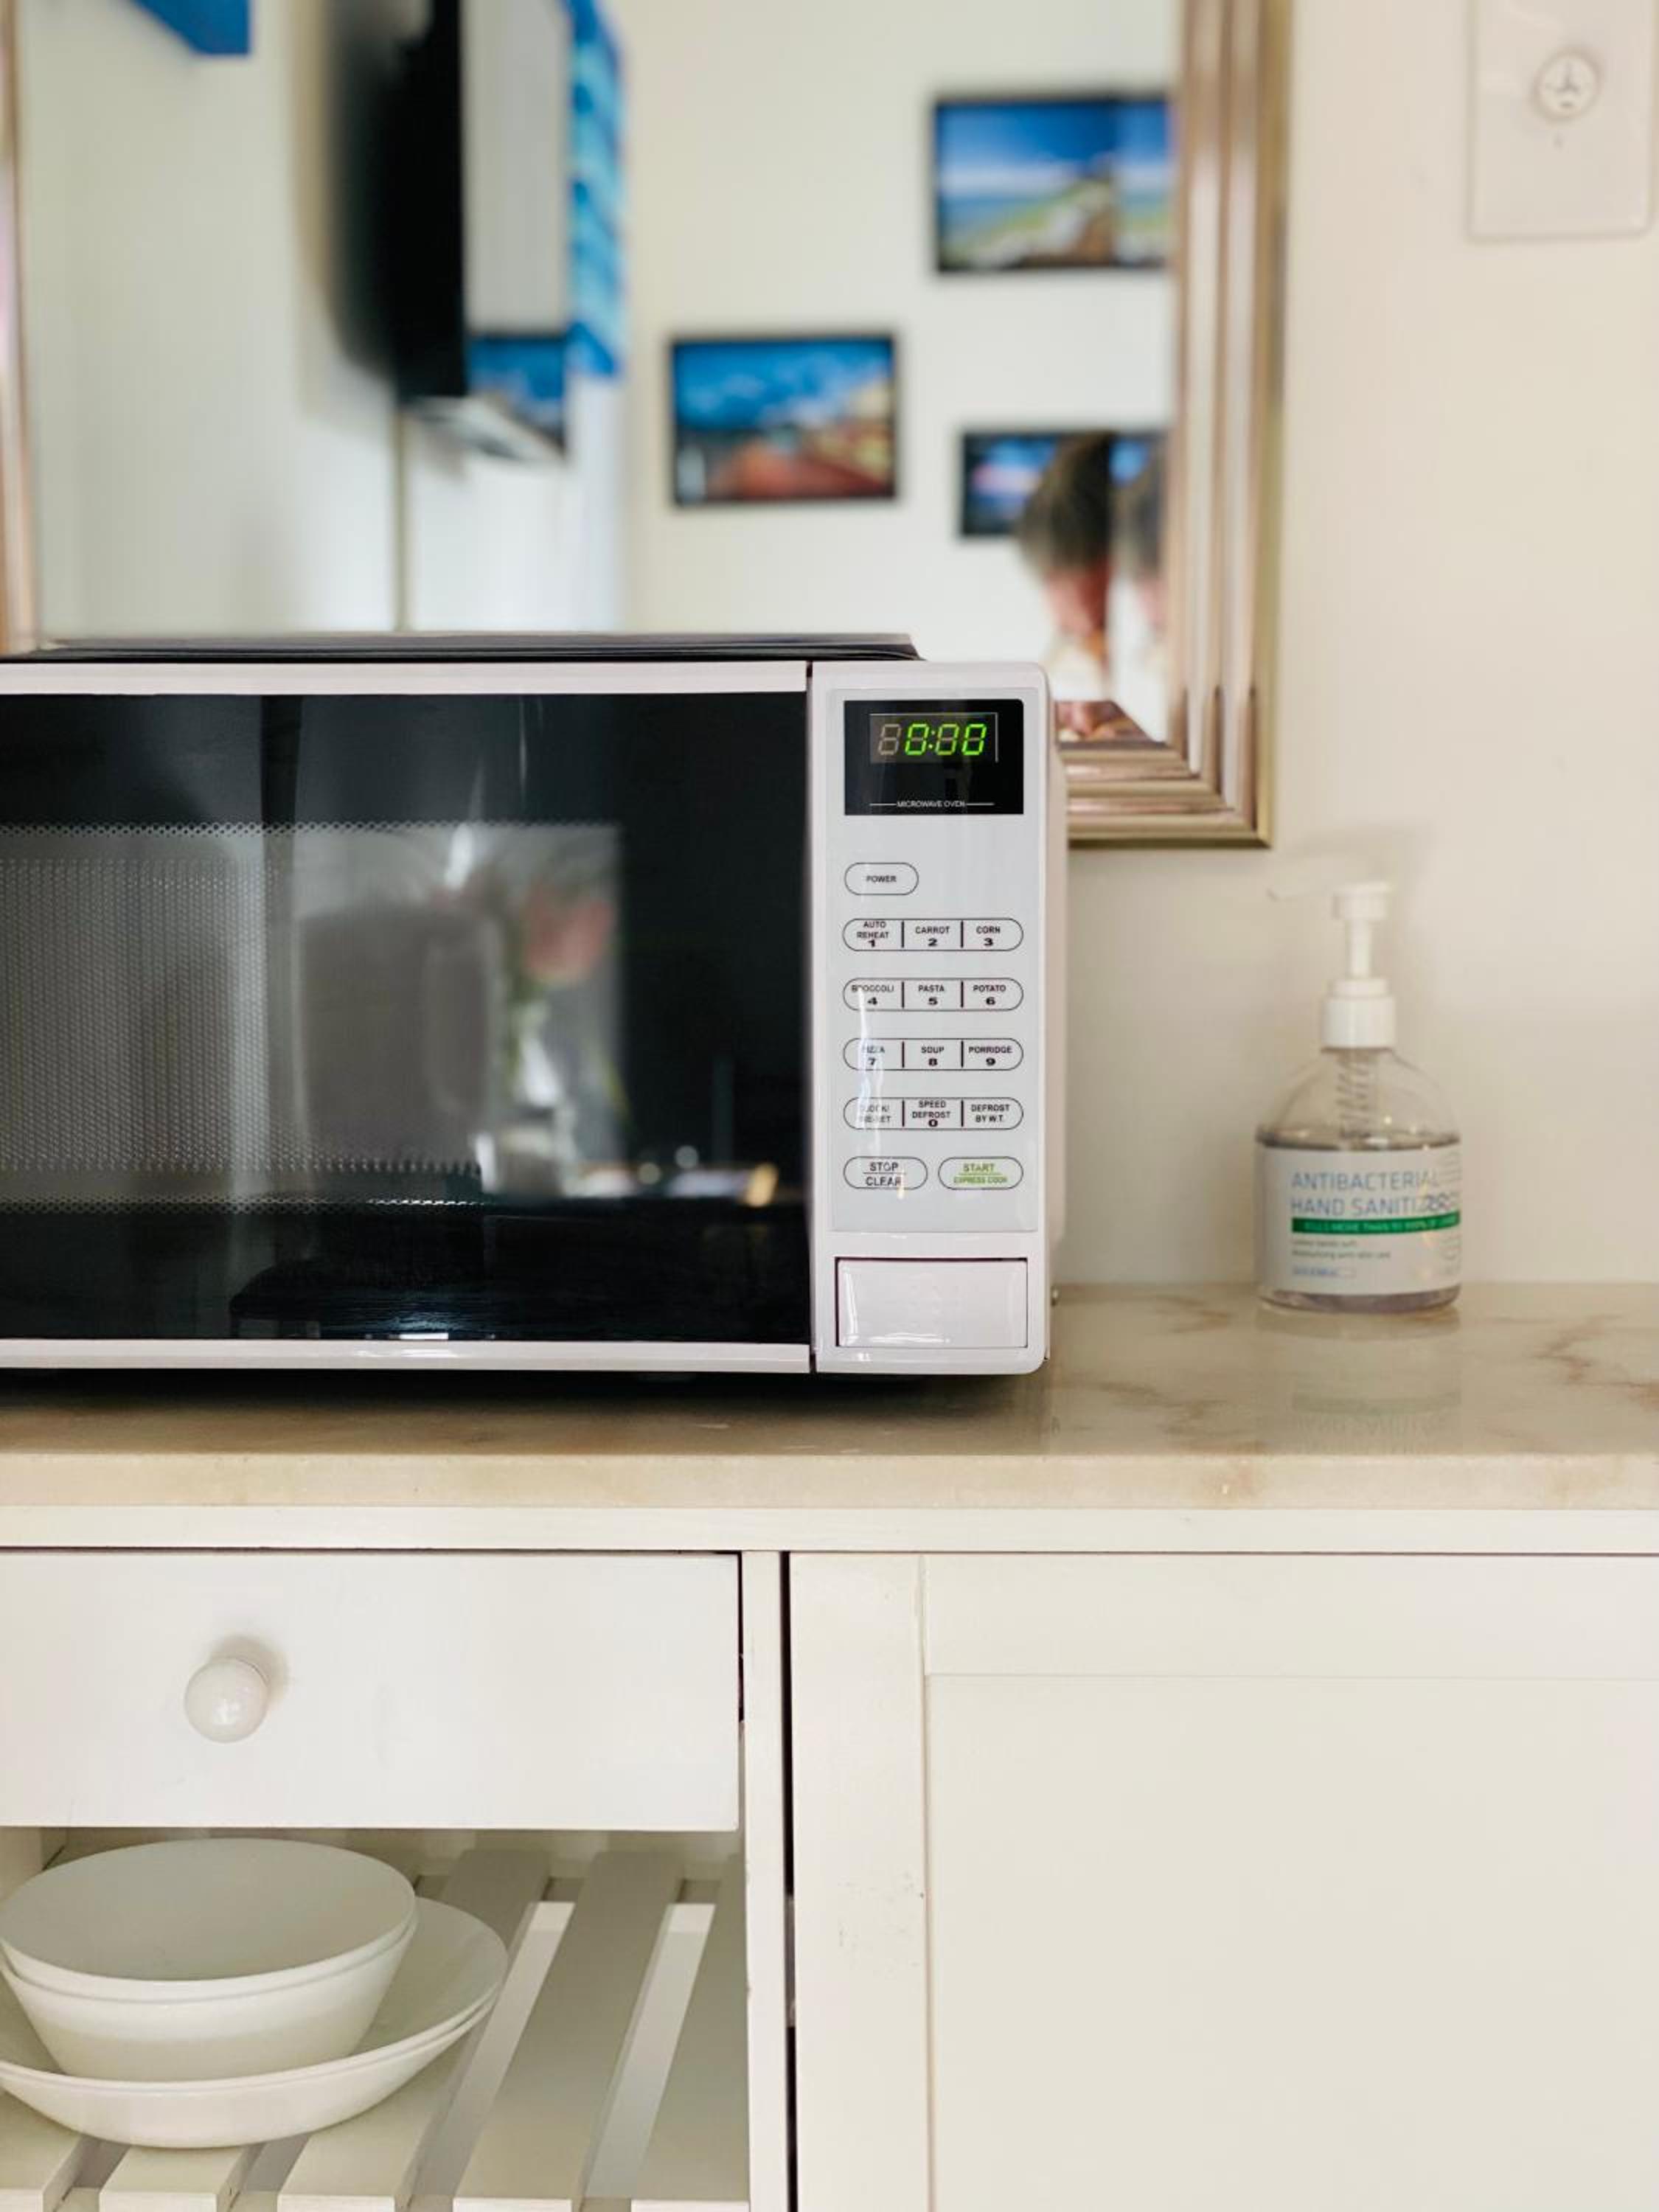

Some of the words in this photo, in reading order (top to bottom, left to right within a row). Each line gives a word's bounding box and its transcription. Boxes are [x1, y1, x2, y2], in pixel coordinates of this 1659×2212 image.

[897, 800, 942, 808] MICROWAVE
[943, 800, 965, 808] OVEN
[866, 874, 897, 883] POWER
[863, 921, 886, 929] AUTO
[915, 925, 950, 934] CARROT
[975, 925, 1001, 934] CORN
[856, 931, 888, 939] REHEAT
[868, 939, 876, 947] 1
[928, 938, 938, 947] 2
[984, 938, 993, 947] 3
[918, 984, 945, 992] PASTA
[973, 984, 1006, 992] POTATO
[867, 997, 877, 1005] 4
[928, 997, 938, 1005] 5
[986, 997, 995, 1005] 6
[921, 1046, 945, 1054] SOUP
[969, 1046, 1013, 1054] PORRIDGE
[868, 1058, 877, 1066] 7
[928, 1058, 938, 1066] 8
[986, 1058, 995, 1066] 9
[918, 1100, 946, 1108] SPEED
[971, 1104, 1009, 1113] DEFROST
[912, 1111, 950, 1119] DEFROST
[975, 1115, 987, 1123] BY
[928, 1119, 939, 1127] 0
[869, 1163, 899, 1172] STOP
[963, 1164, 995, 1172] START
[866, 1176, 902, 1186] CLEAR
[1290, 1170, 1440, 1192] ANTIBACTERIAL
[1290, 1196, 1345, 1216] HAND
